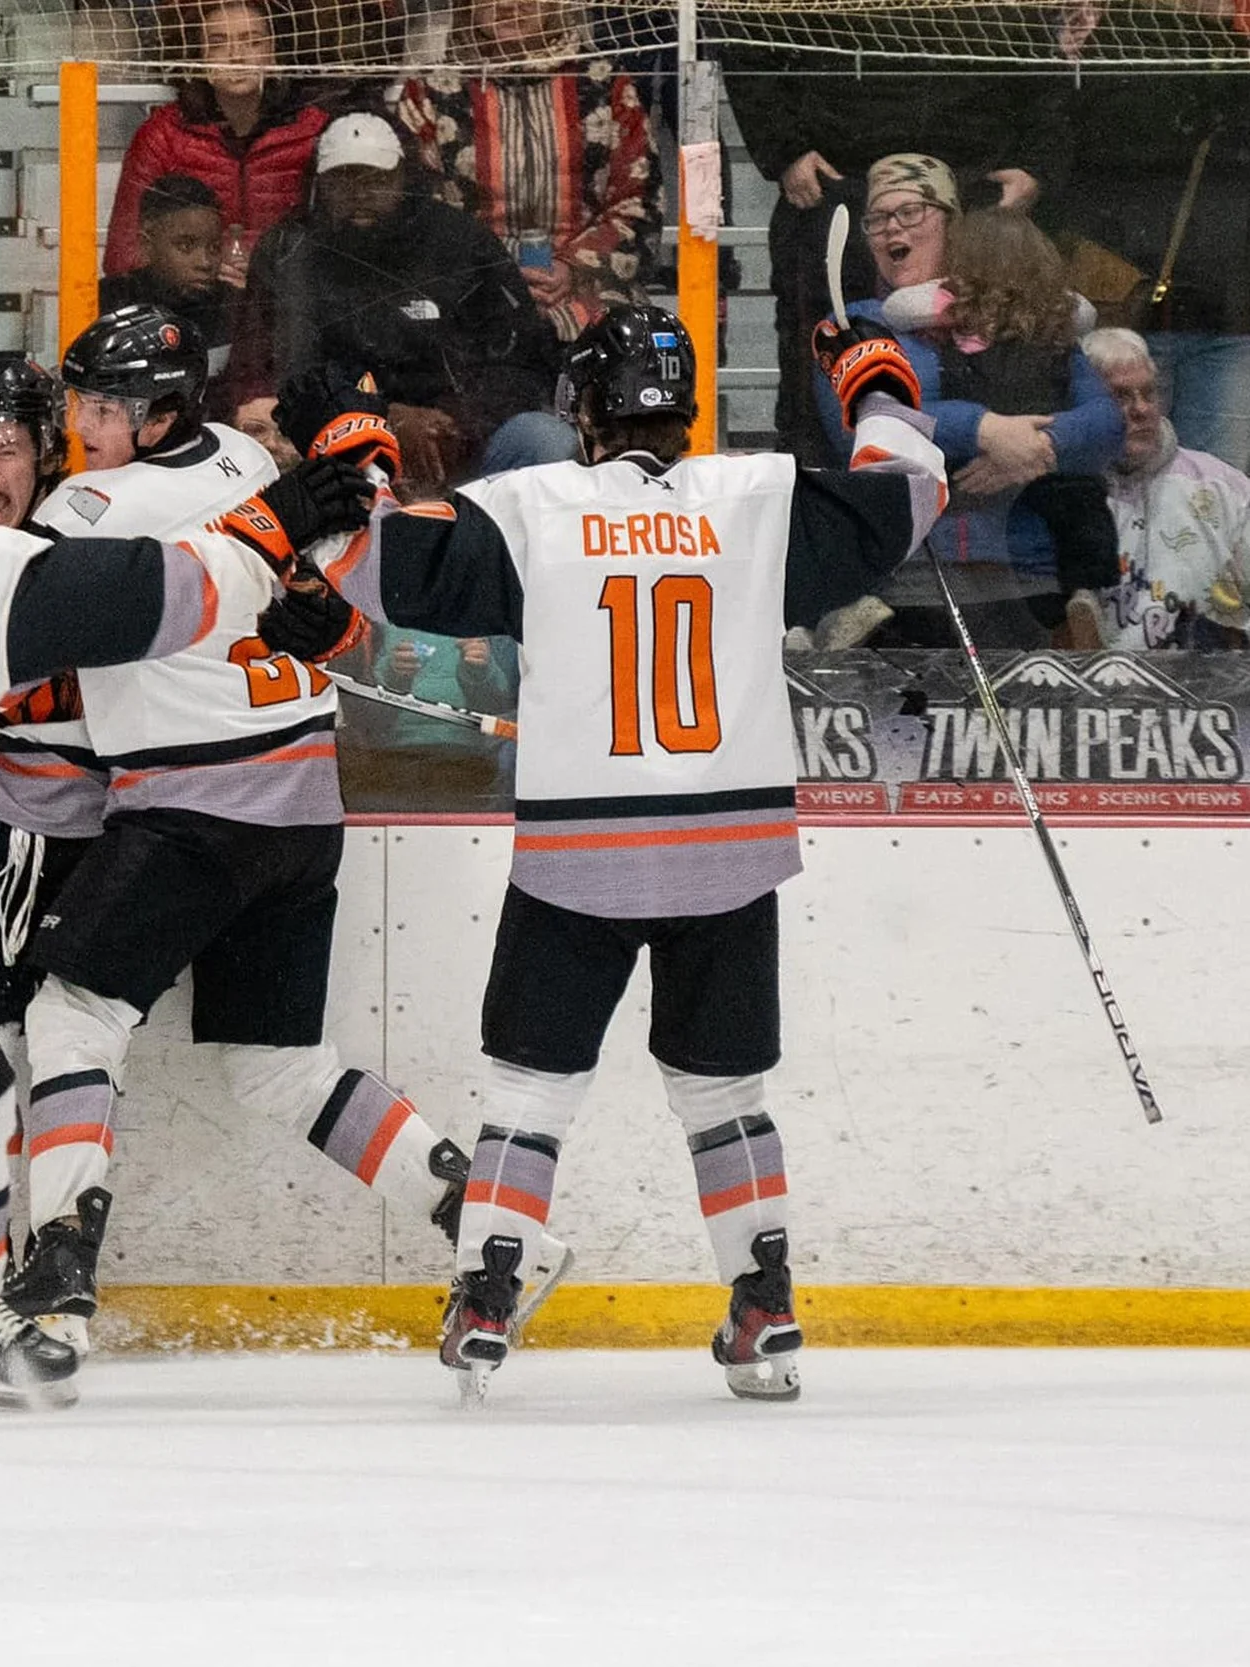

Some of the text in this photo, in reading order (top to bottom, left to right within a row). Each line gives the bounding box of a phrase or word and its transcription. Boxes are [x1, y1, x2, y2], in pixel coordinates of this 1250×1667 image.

[659, 353, 680, 380] 10
[598, 574, 722, 757] 10
[926, 708, 1061, 778] TWIN
[1077, 708, 1238, 779] PEAKS
[810, 791, 877, 804] VIEWS
[914, 791, 1242, 805] EATS DRNKS SCENIC VIEWS
